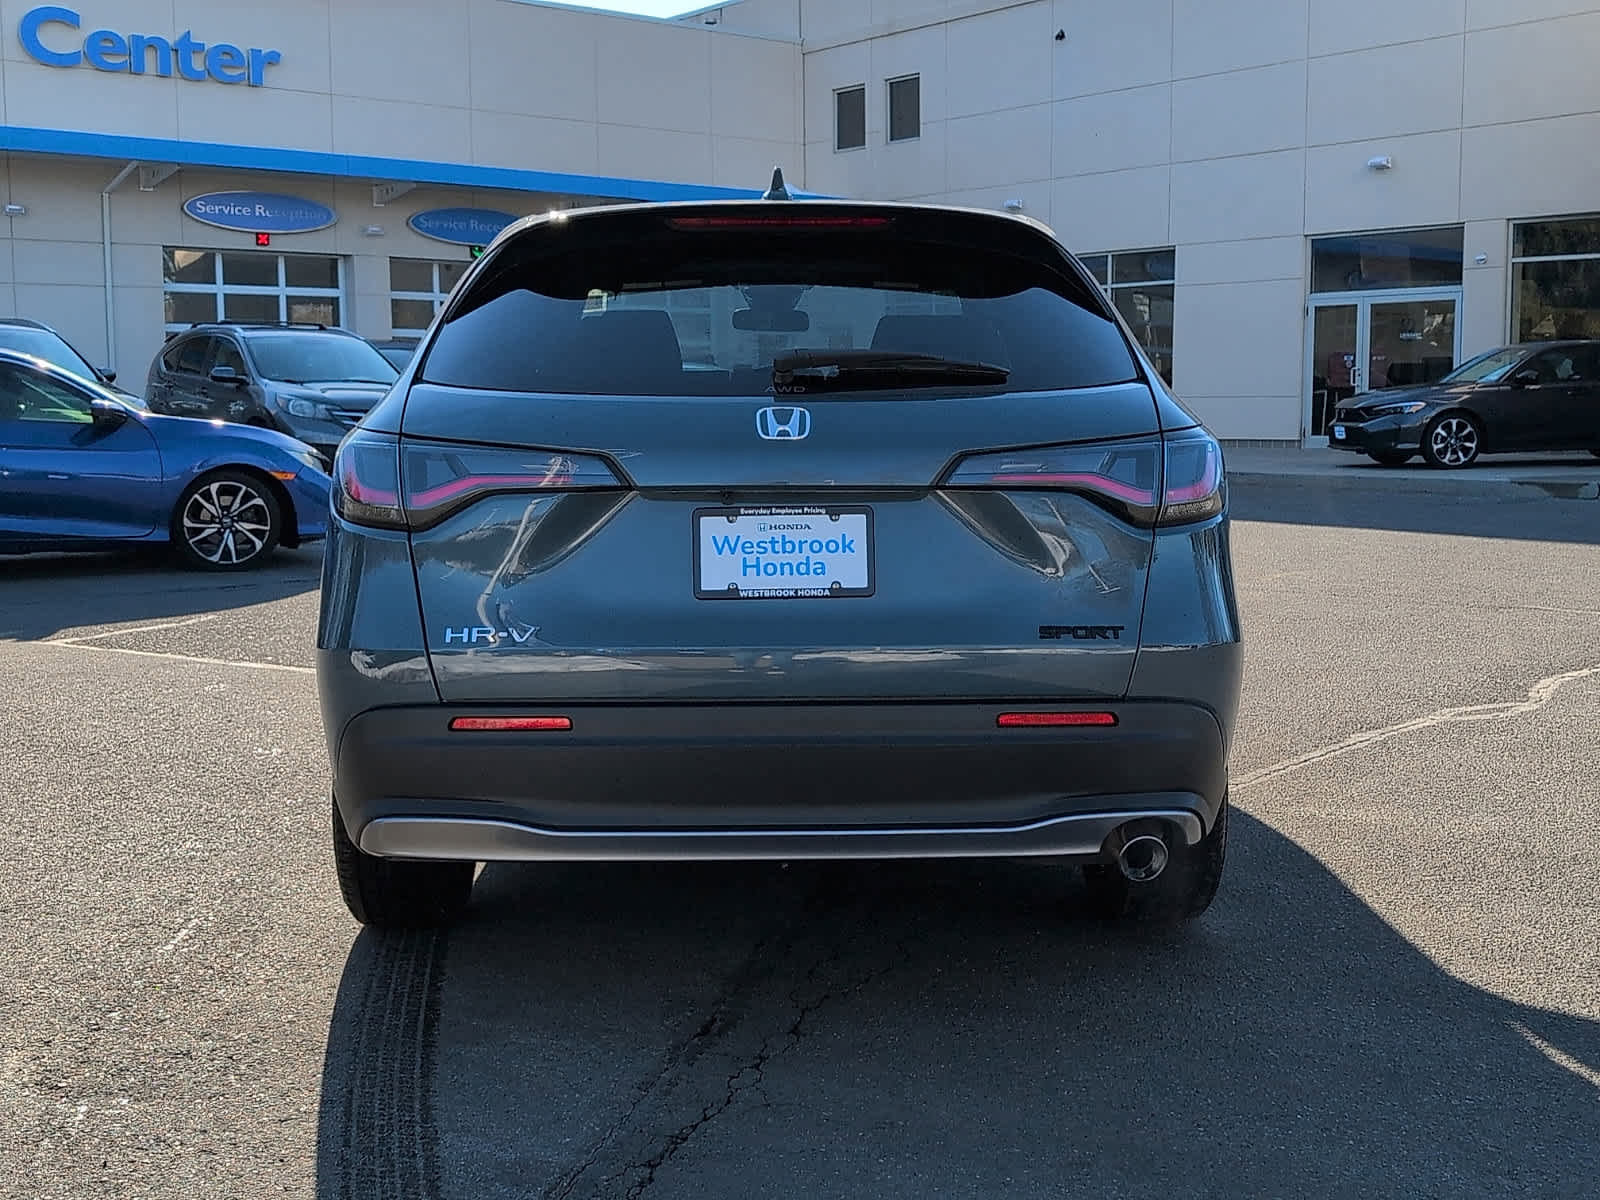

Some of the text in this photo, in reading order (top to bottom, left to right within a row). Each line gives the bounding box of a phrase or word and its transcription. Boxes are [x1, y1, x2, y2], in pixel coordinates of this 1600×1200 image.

[18, 5, 282, 87] Center
[196, 200, 251, 216] Service
[740, 506, 826, 515] Everyday Employee Pricing
[769, 523, 812, 531] HONDA
[711, 533, 855, 555] Westbrook
[742, 556, 826, 577] Honda
[739, 588, 831, 598] WESTBROOK HONDA
[445, 627, 536, 643] HR-V
[1038, 625, 1124, 640] SPORT
